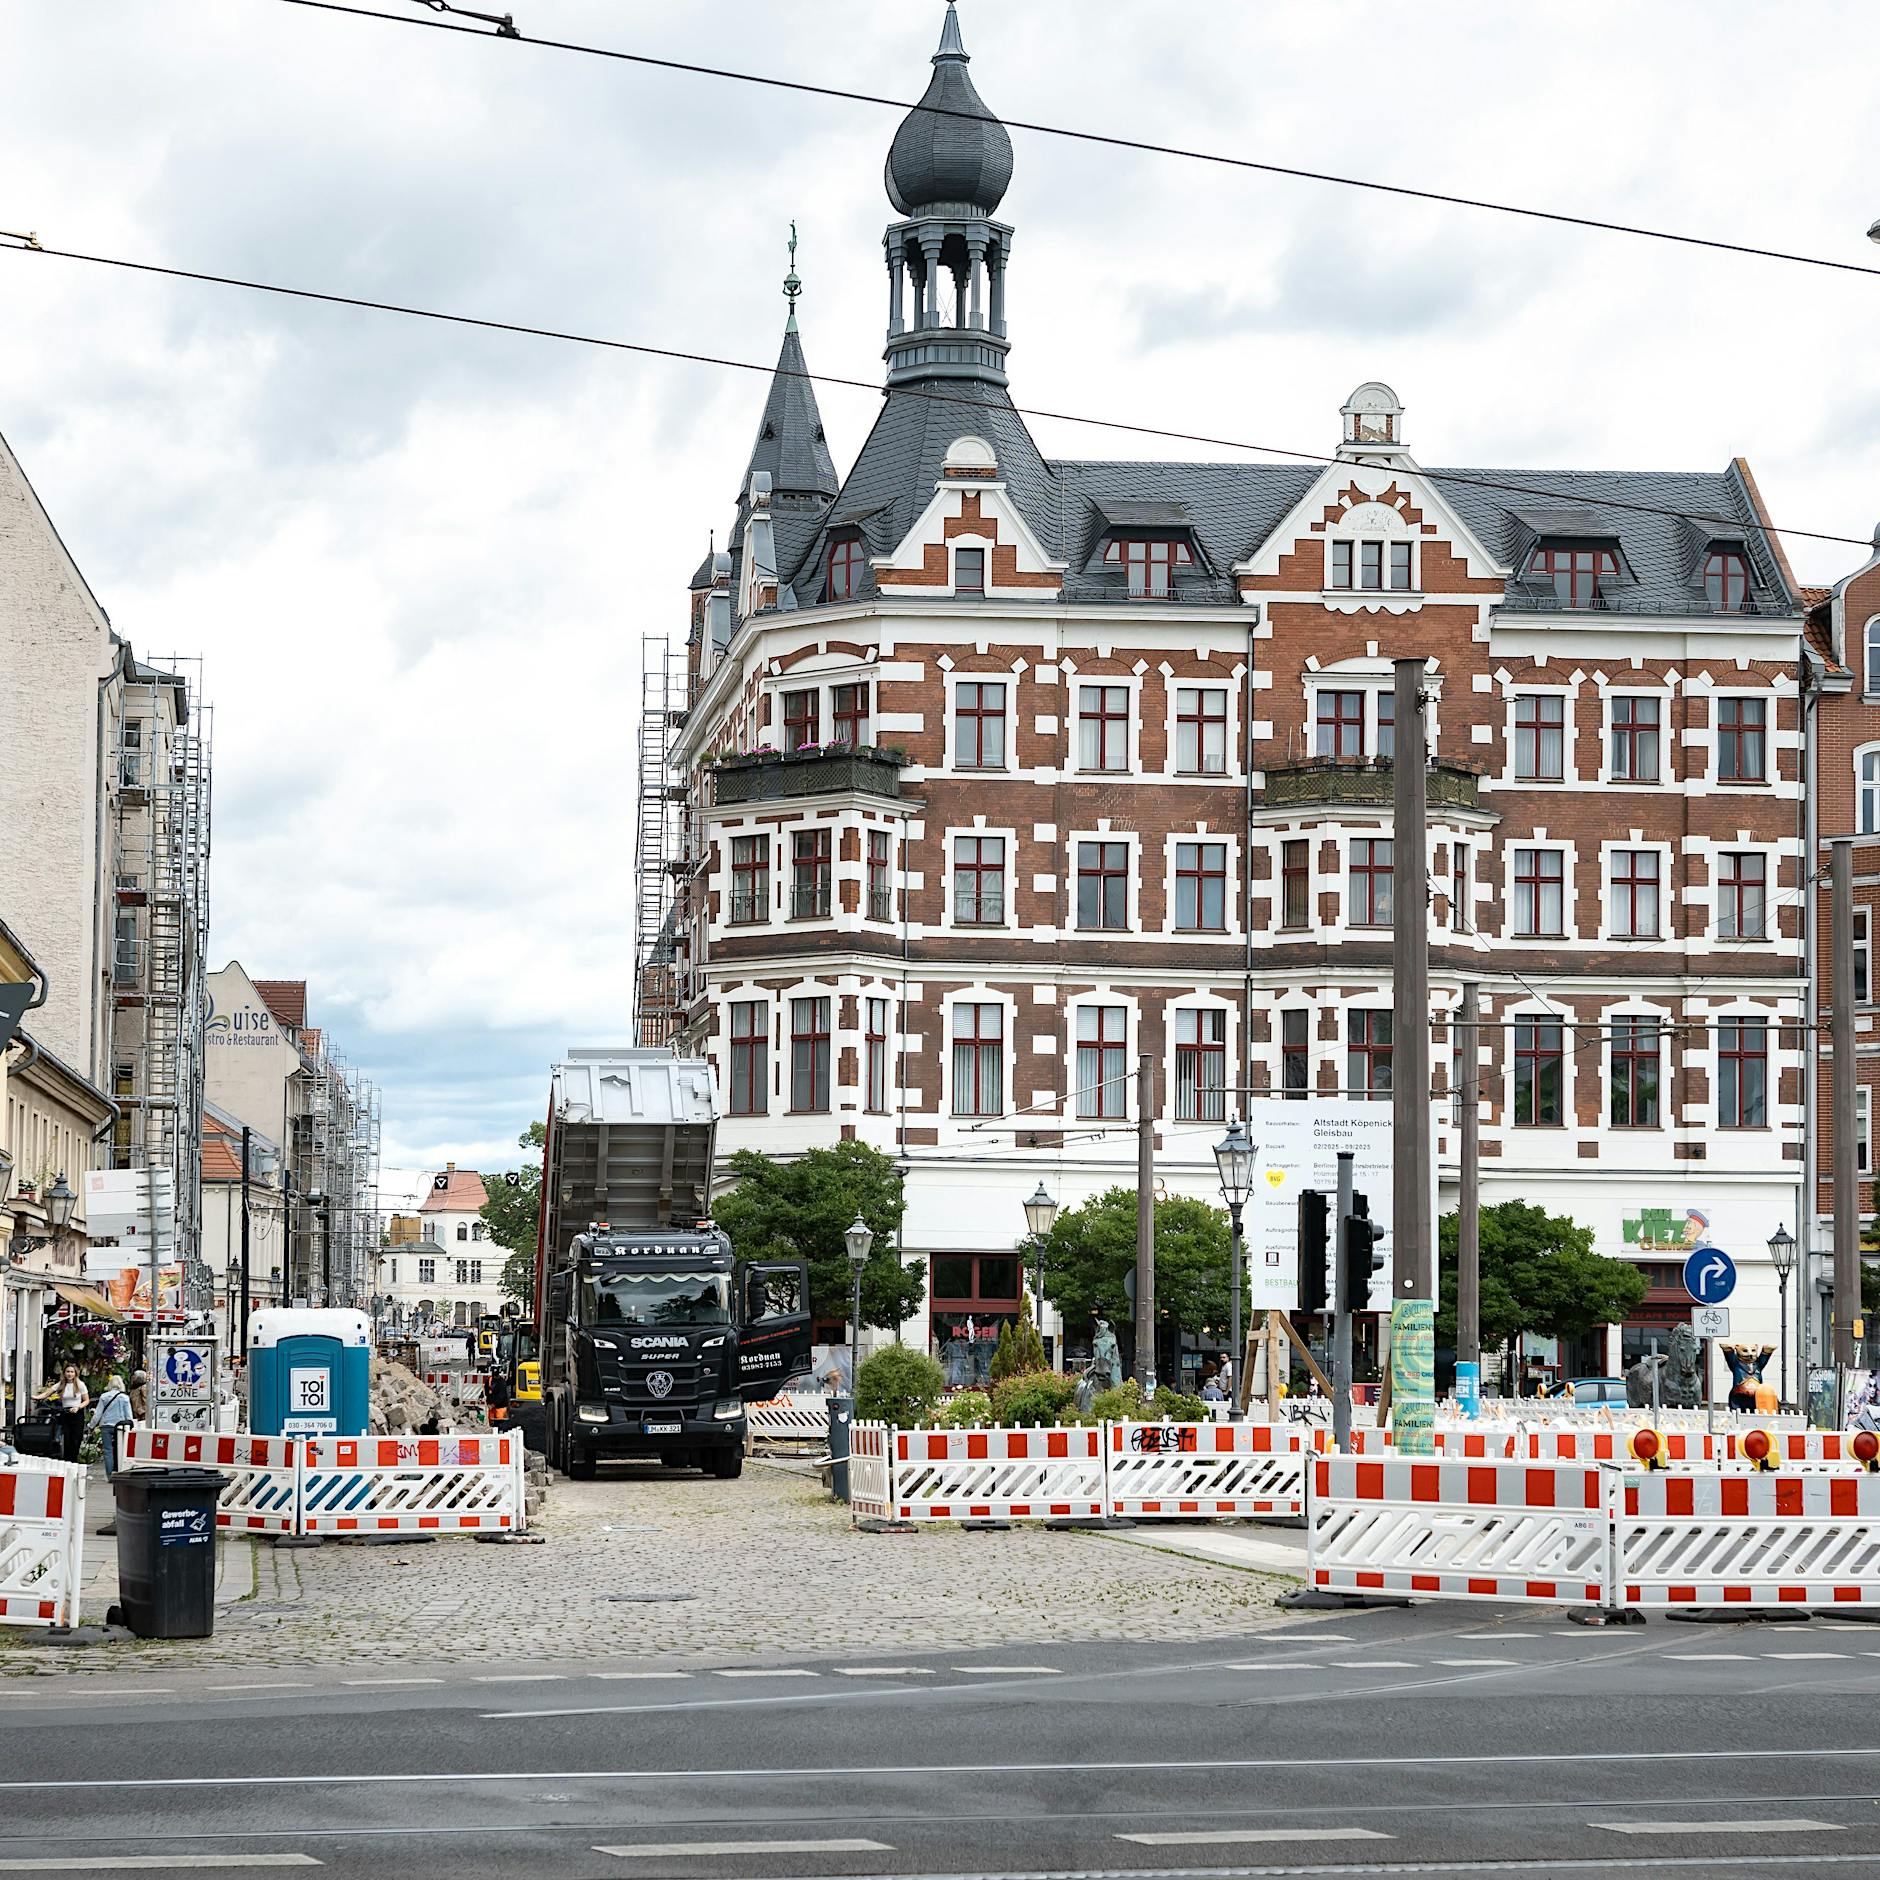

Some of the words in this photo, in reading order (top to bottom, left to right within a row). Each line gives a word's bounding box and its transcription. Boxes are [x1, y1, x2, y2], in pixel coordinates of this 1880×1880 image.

[203, 1032, 225, 1046] istro
[233, 1033, 279, 1046] Restaurant
[1313, 1119, 1348, 1127] Altstadt
[1350, 1117, 1393, 1129] Köpenick
[1313, 1129, 1353, 1137] Gleisbau
[1622, 1219, 1688, 1243] KIEZ
[614, 1245, 700, 1256] Korduan
[1705, 1326, 1718, 1334] frei
[630, 1337, 689, 1349] SCANIA
[740, 1352, 781, 1365] Korduan
[300, 1380, 324, 1393] TOI
[1809, 1381, 1823, 1393] ERDE
[170, 1388, 198, 1398] ZONE
[300, 1393, 324, 1406] TOI
[161, 1519, 185, 1529] abfall
